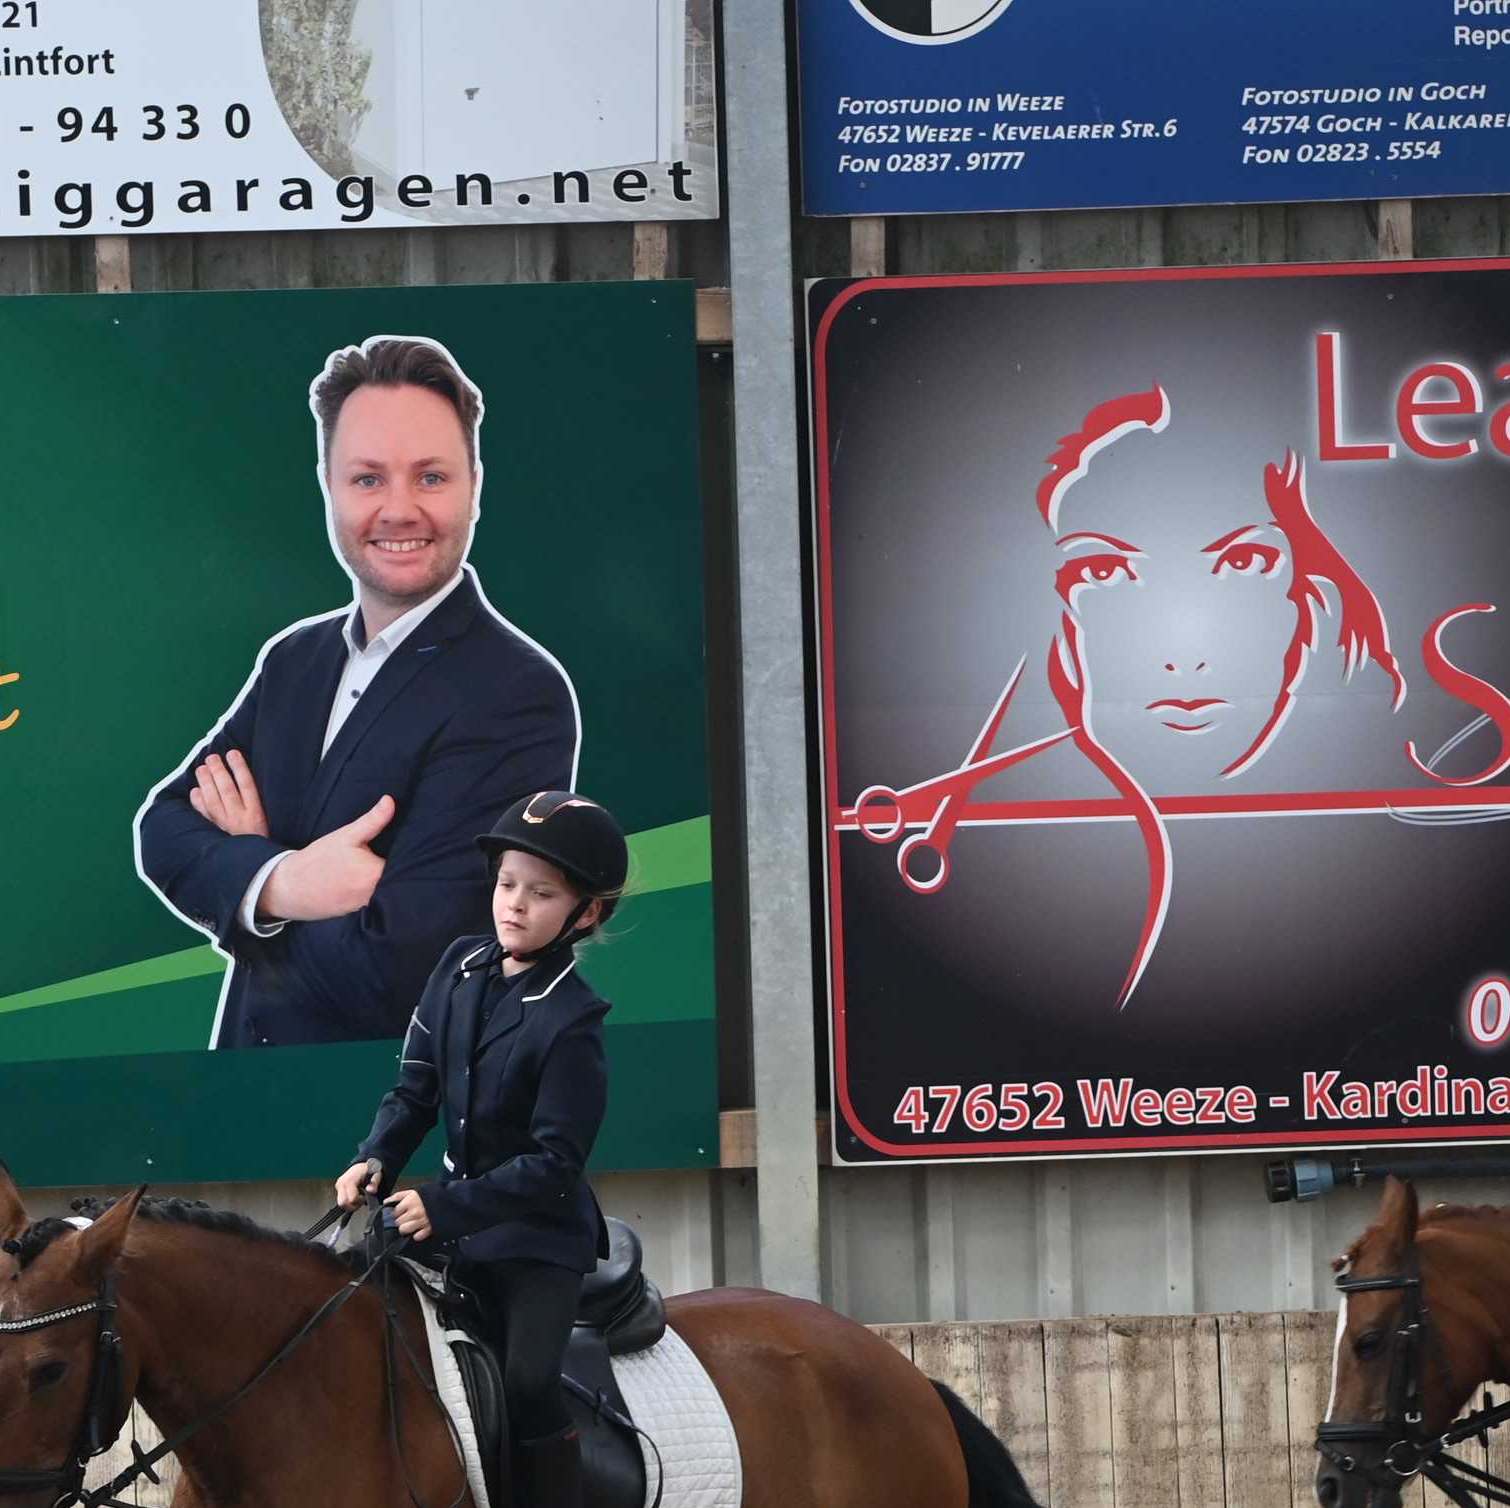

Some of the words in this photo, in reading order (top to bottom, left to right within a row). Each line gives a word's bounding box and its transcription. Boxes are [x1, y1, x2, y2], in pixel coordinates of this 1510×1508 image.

[2, 2, 37, 28] 21
[57, 107, 117, 142] 94
[143, 105, 199, 140] 33
[225, 103, 250, 138] 0
[1242, 116, 1310, 134] 47574
[838, 125, 900, 143] 47652
[887, 153, 951, 172] 02837
[967, 152, 1025, 171] 91777
[1297, 143, 1369, 162] 02823
[1387, 141, 1441, 160] 5554
[893, 1082, 1067, 1134] 47652
[1077, 1077, 1257, 1128] Weeze
